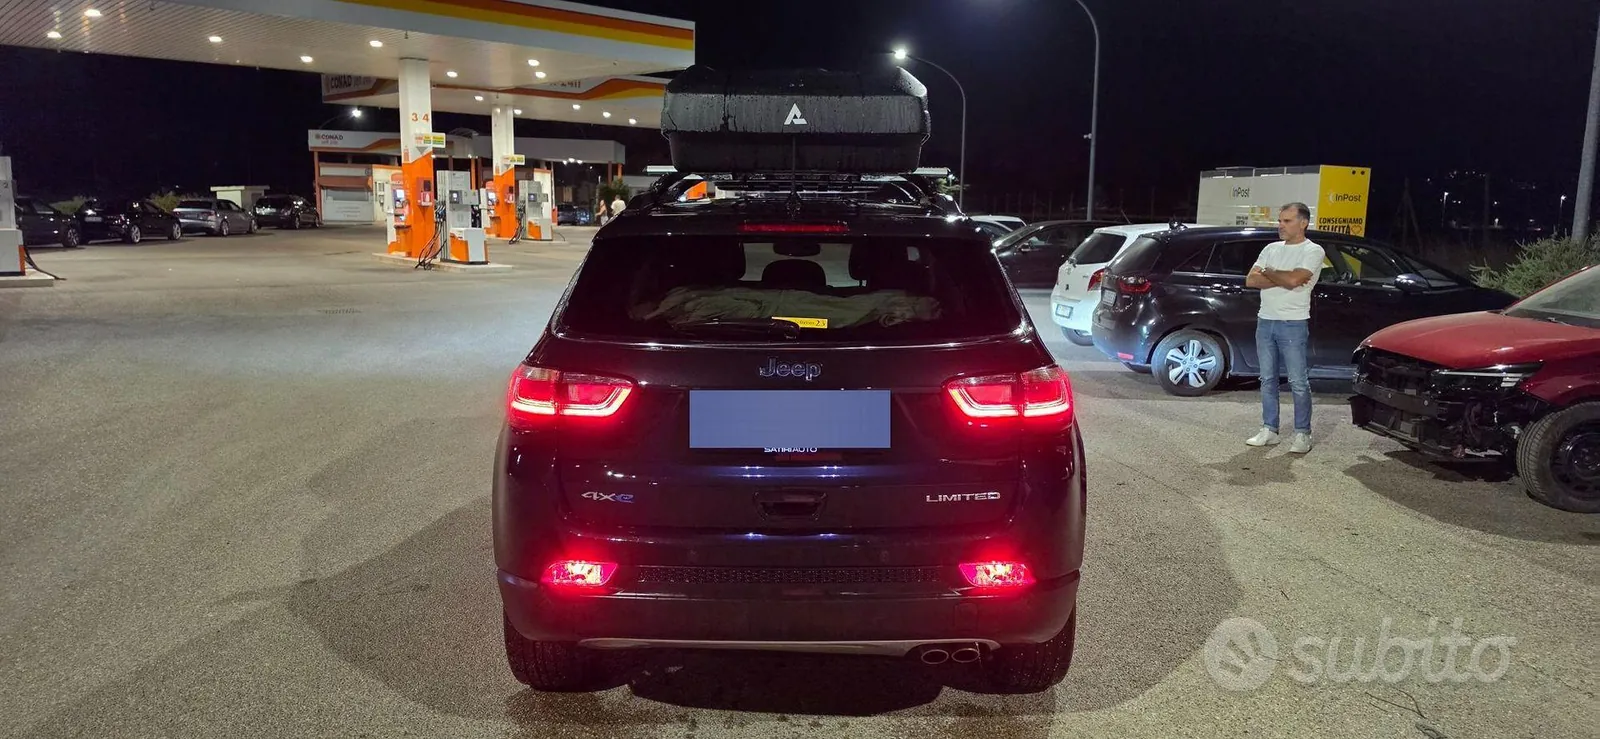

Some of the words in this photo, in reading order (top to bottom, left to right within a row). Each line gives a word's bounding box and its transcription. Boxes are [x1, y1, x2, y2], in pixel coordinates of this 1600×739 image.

[330, 74, 352, 89] CONAD
[411, 112, 419, 122] 3
[422, 113, 430, 122] 4
[321, 133, 344, 141] CONAD
[1232, 186, 1251, 198] InPost
[1335, 193, 1362, 202] InPost
[1318, 217, 1363, 225] CONSEGNIAMO
[759, 357, 822, 381] Jeep
[925, 491, 1001, 503] LIMITED
